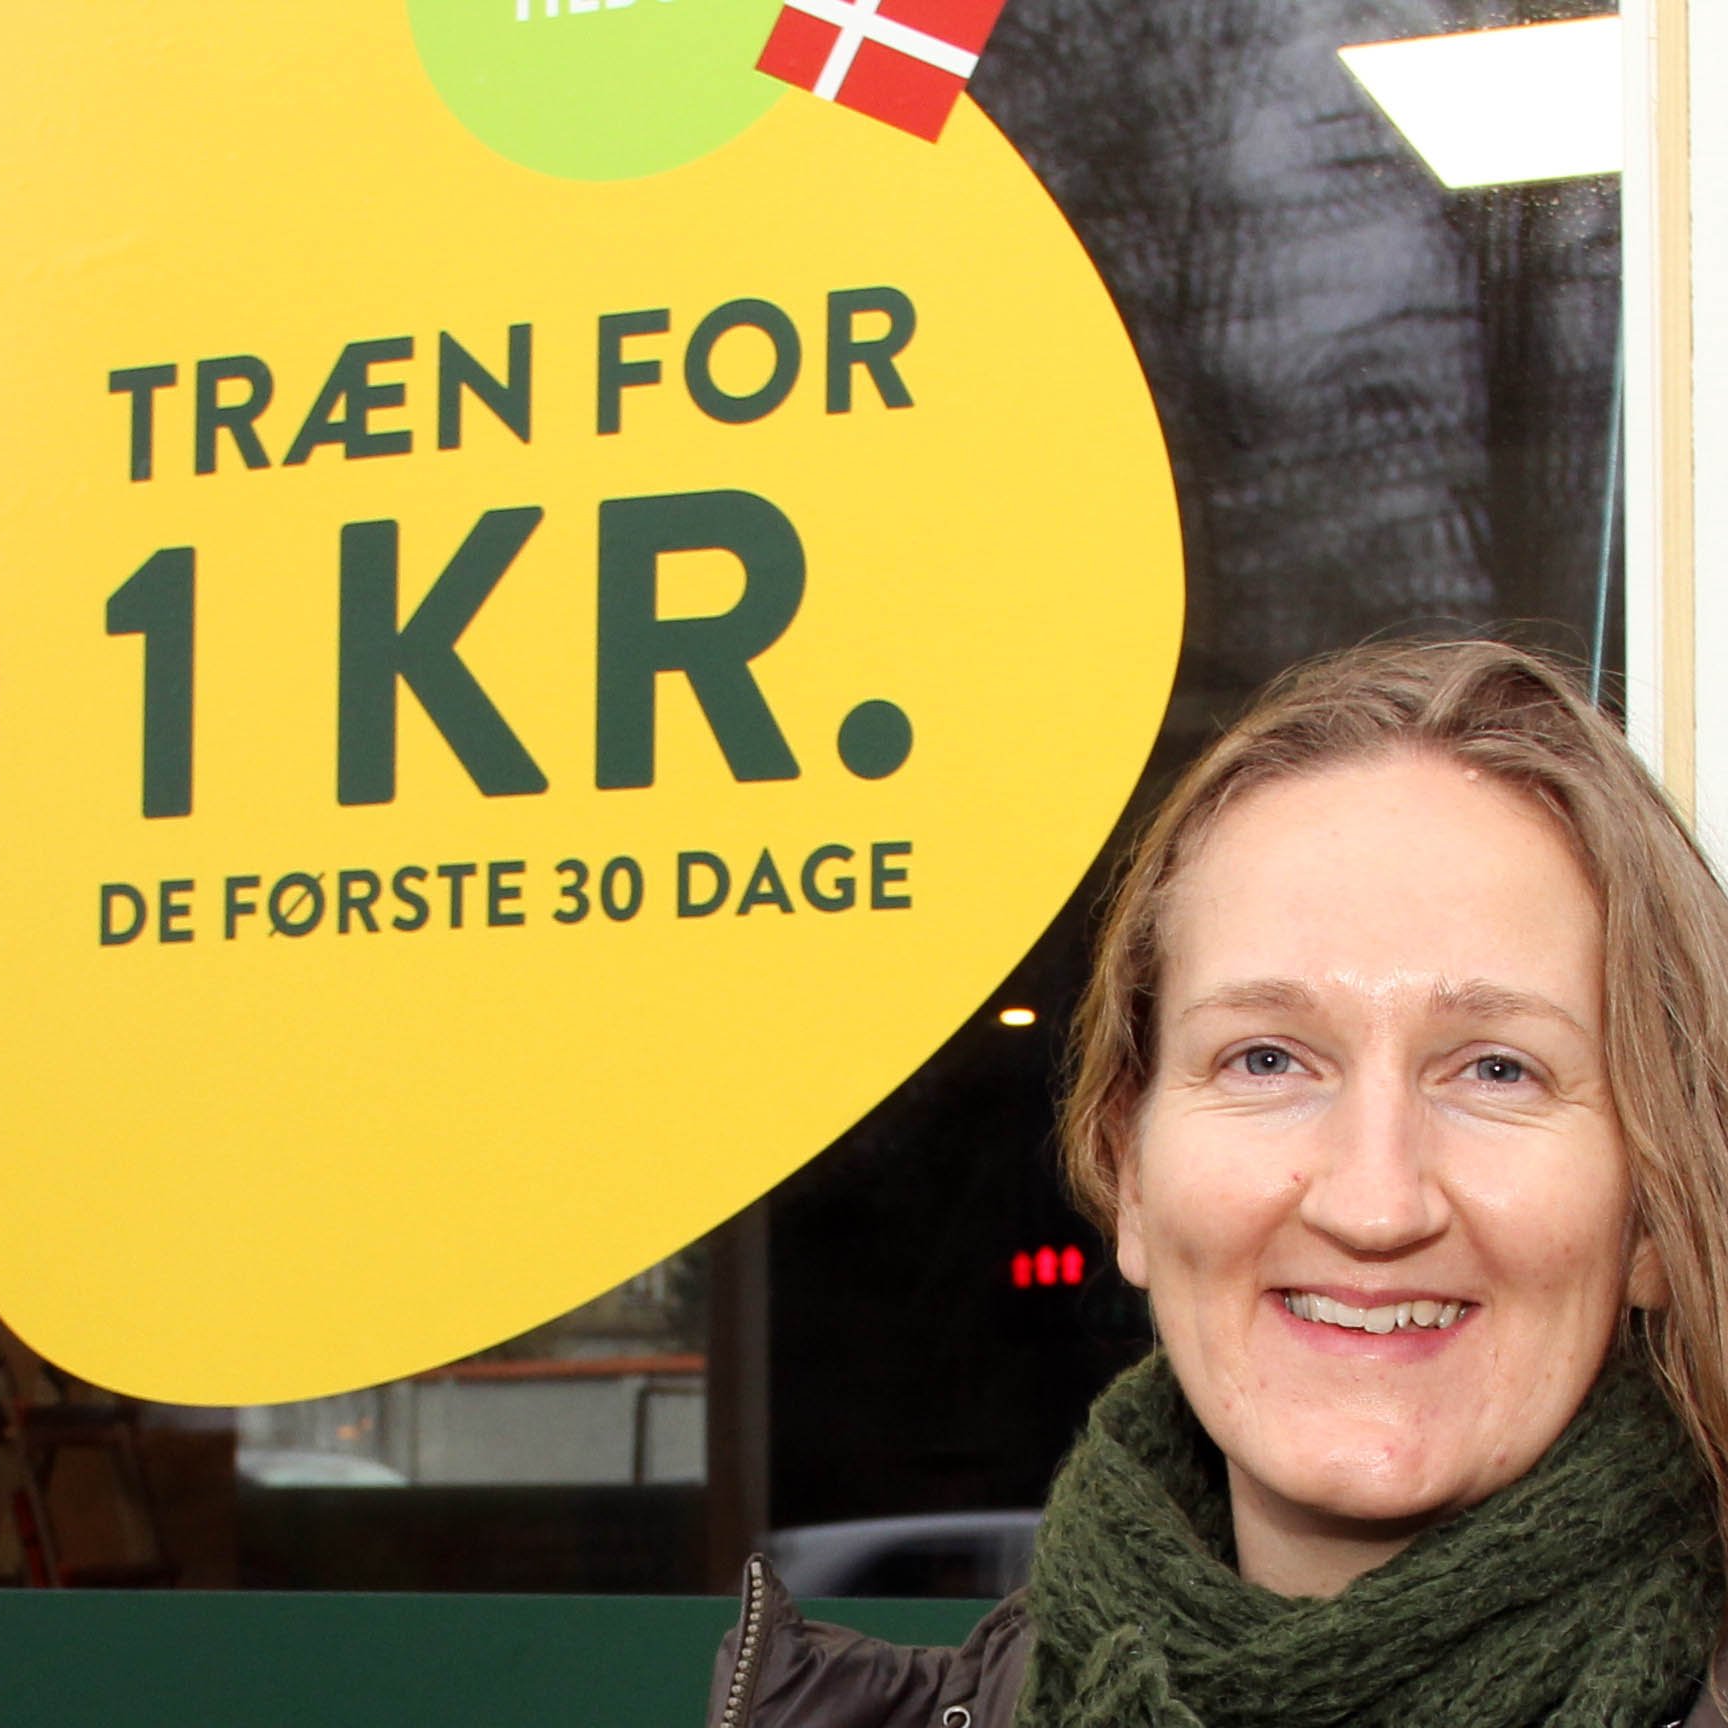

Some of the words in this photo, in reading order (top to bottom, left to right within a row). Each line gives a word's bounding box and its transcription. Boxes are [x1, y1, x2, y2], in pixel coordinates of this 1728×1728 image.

[107, 322, 533, 484] TRÆN
[595, 285, 917, 437] FOR
[104, 545, 197, 821] 1
[335, 488, 914, 808] KR.
[99, 878, 196, 948] DE
[223, 859, 527, 942] FØRSTE
[552, 855, 645, 929] 30
[676, 840, 913, 920] DAGE
